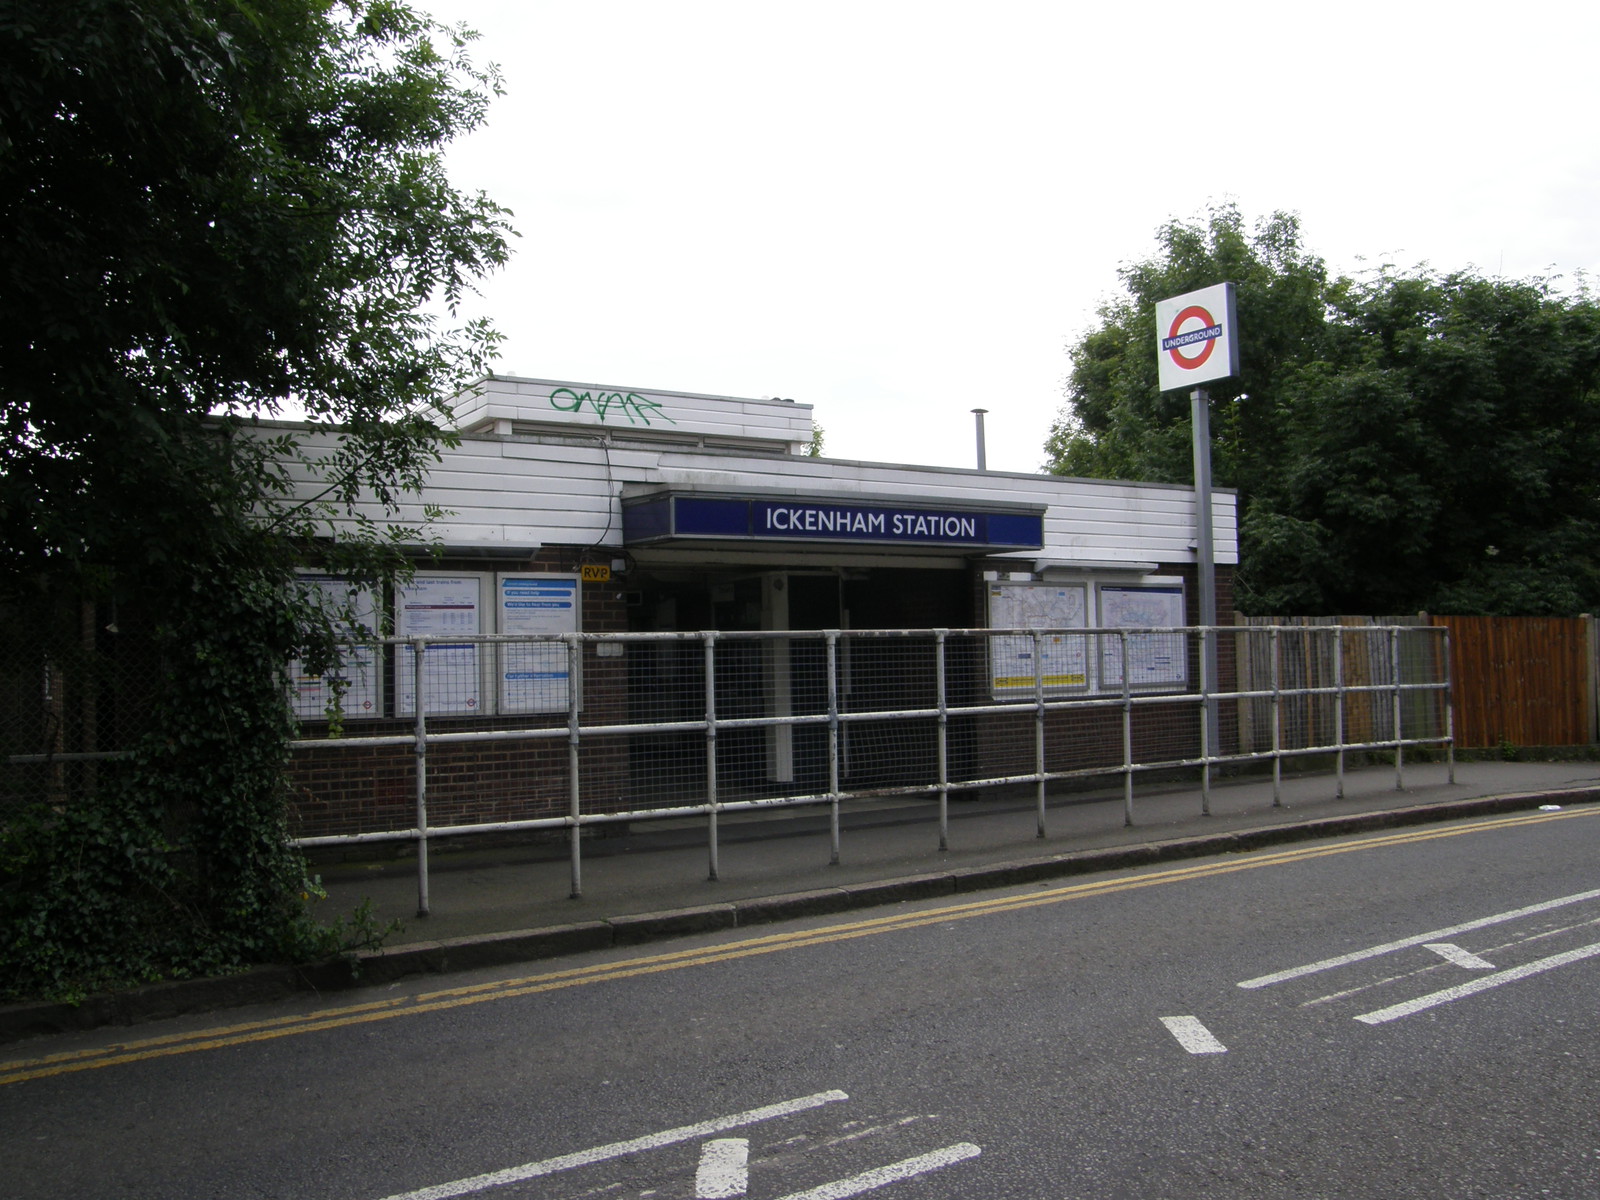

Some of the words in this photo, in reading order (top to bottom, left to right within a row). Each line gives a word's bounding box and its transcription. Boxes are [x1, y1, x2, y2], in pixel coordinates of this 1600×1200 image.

[1164, 327, 1221, 348] UNDERGROUND
[766, 507, 885, 534] ICKENHAM
[893, 514, 976, 538] STATION
[584, 567, 608, 578] RVP
